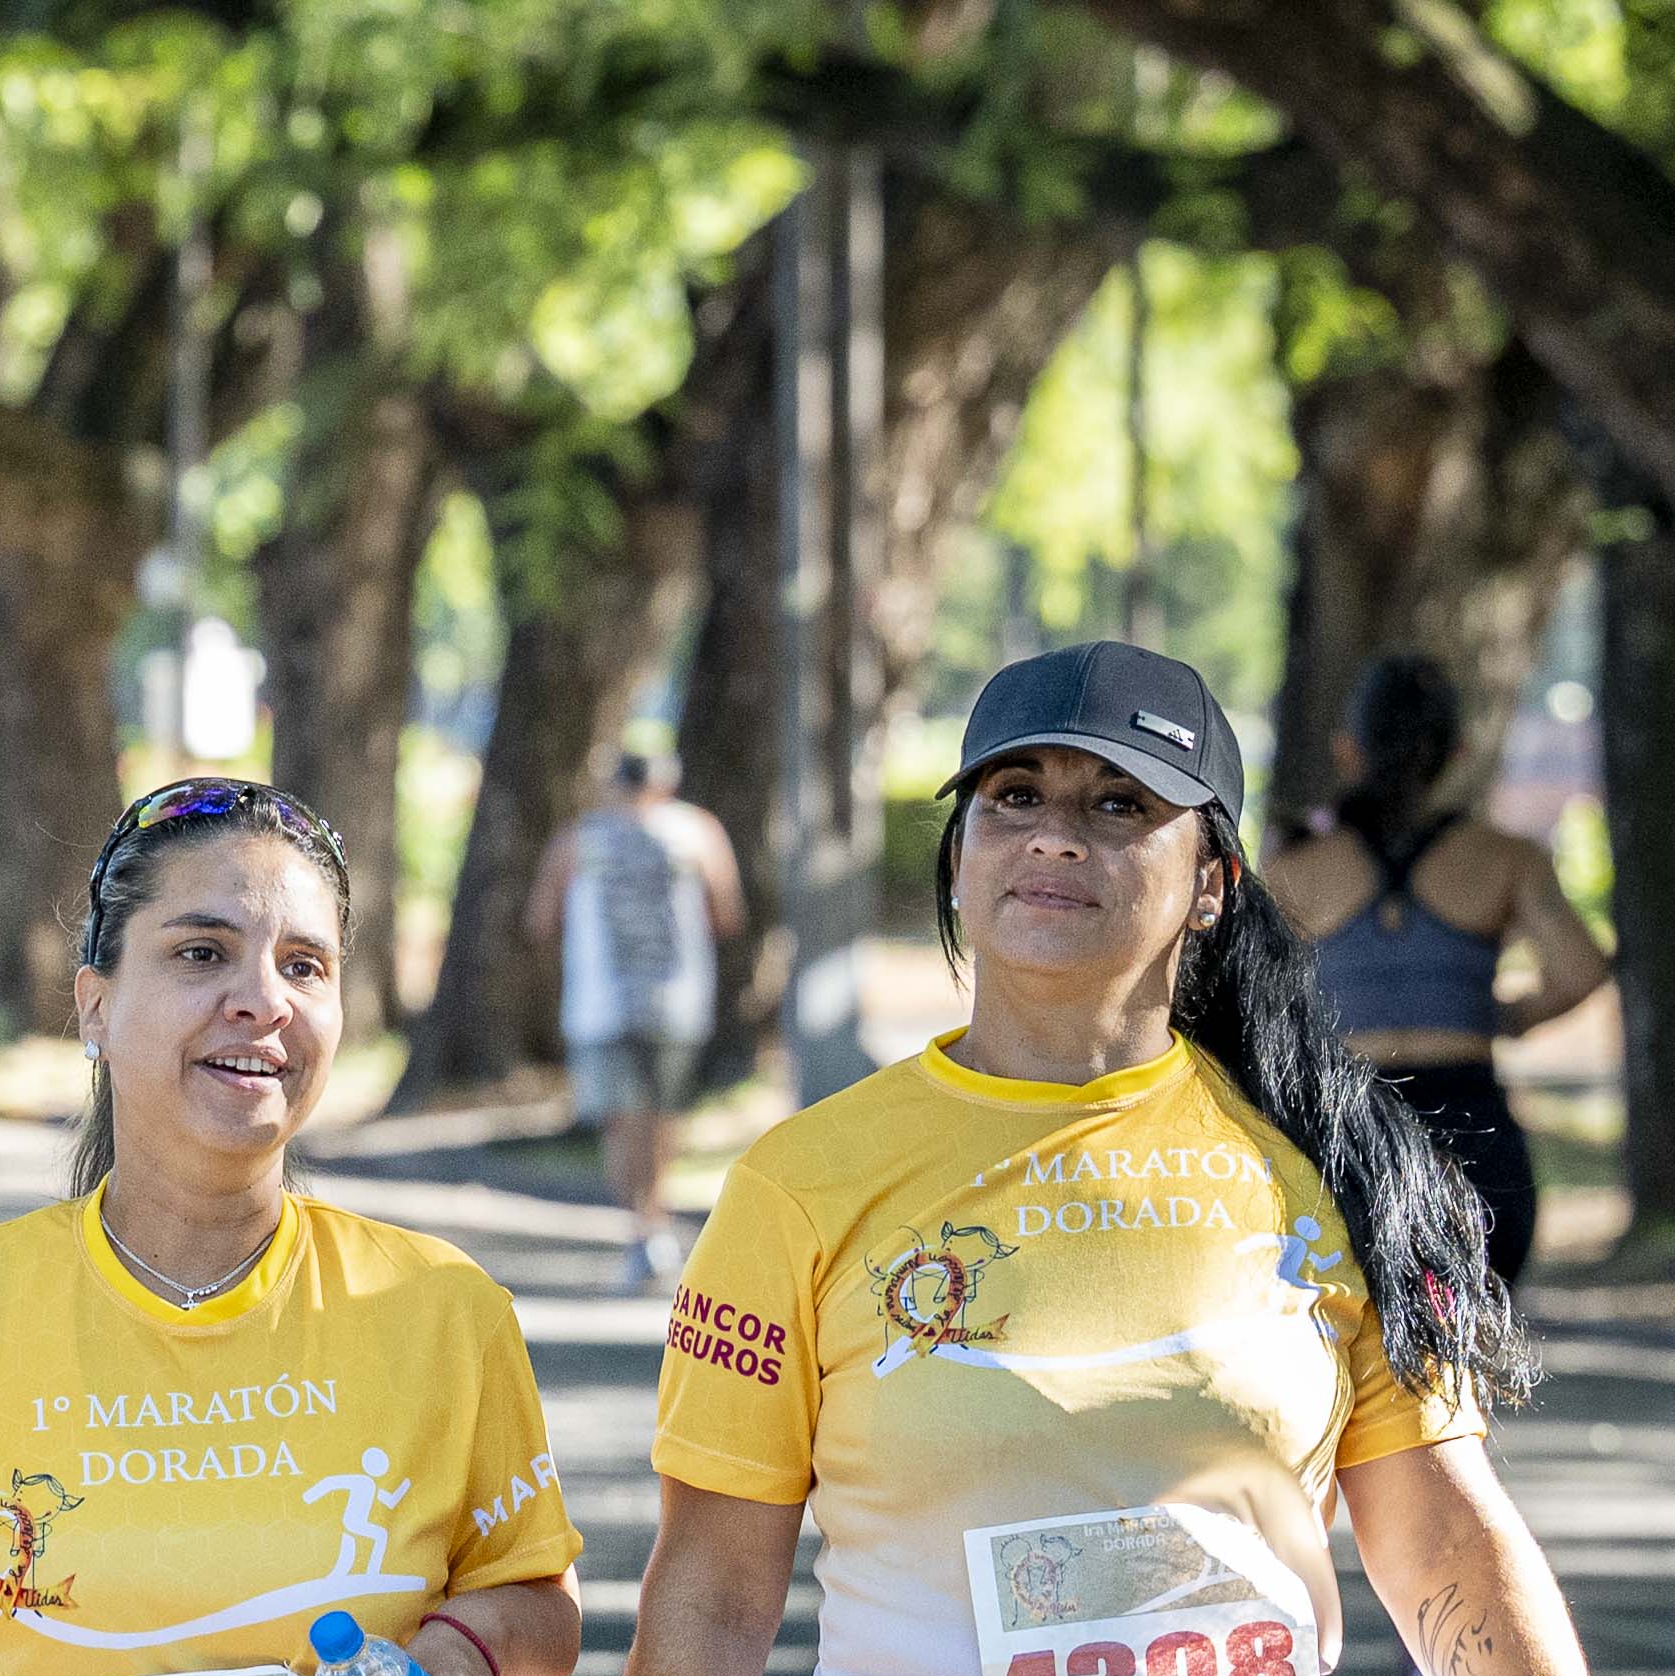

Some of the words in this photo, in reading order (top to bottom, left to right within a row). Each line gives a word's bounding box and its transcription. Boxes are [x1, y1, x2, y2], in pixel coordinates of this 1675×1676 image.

[1021, 1143, 1272, 1187] MARATÓN
[1014, 1196, 1236, 1237] DORADA
[673, 1284, 786, 1355] SANCOR
[666, 1318, 782, 1386] SEGUROS
[85, 1373, 337, 1428] MARATÓN
[79, 1440, 304, 1486] DORADA
[1103, 1533, 1166, 1552] DORADA
